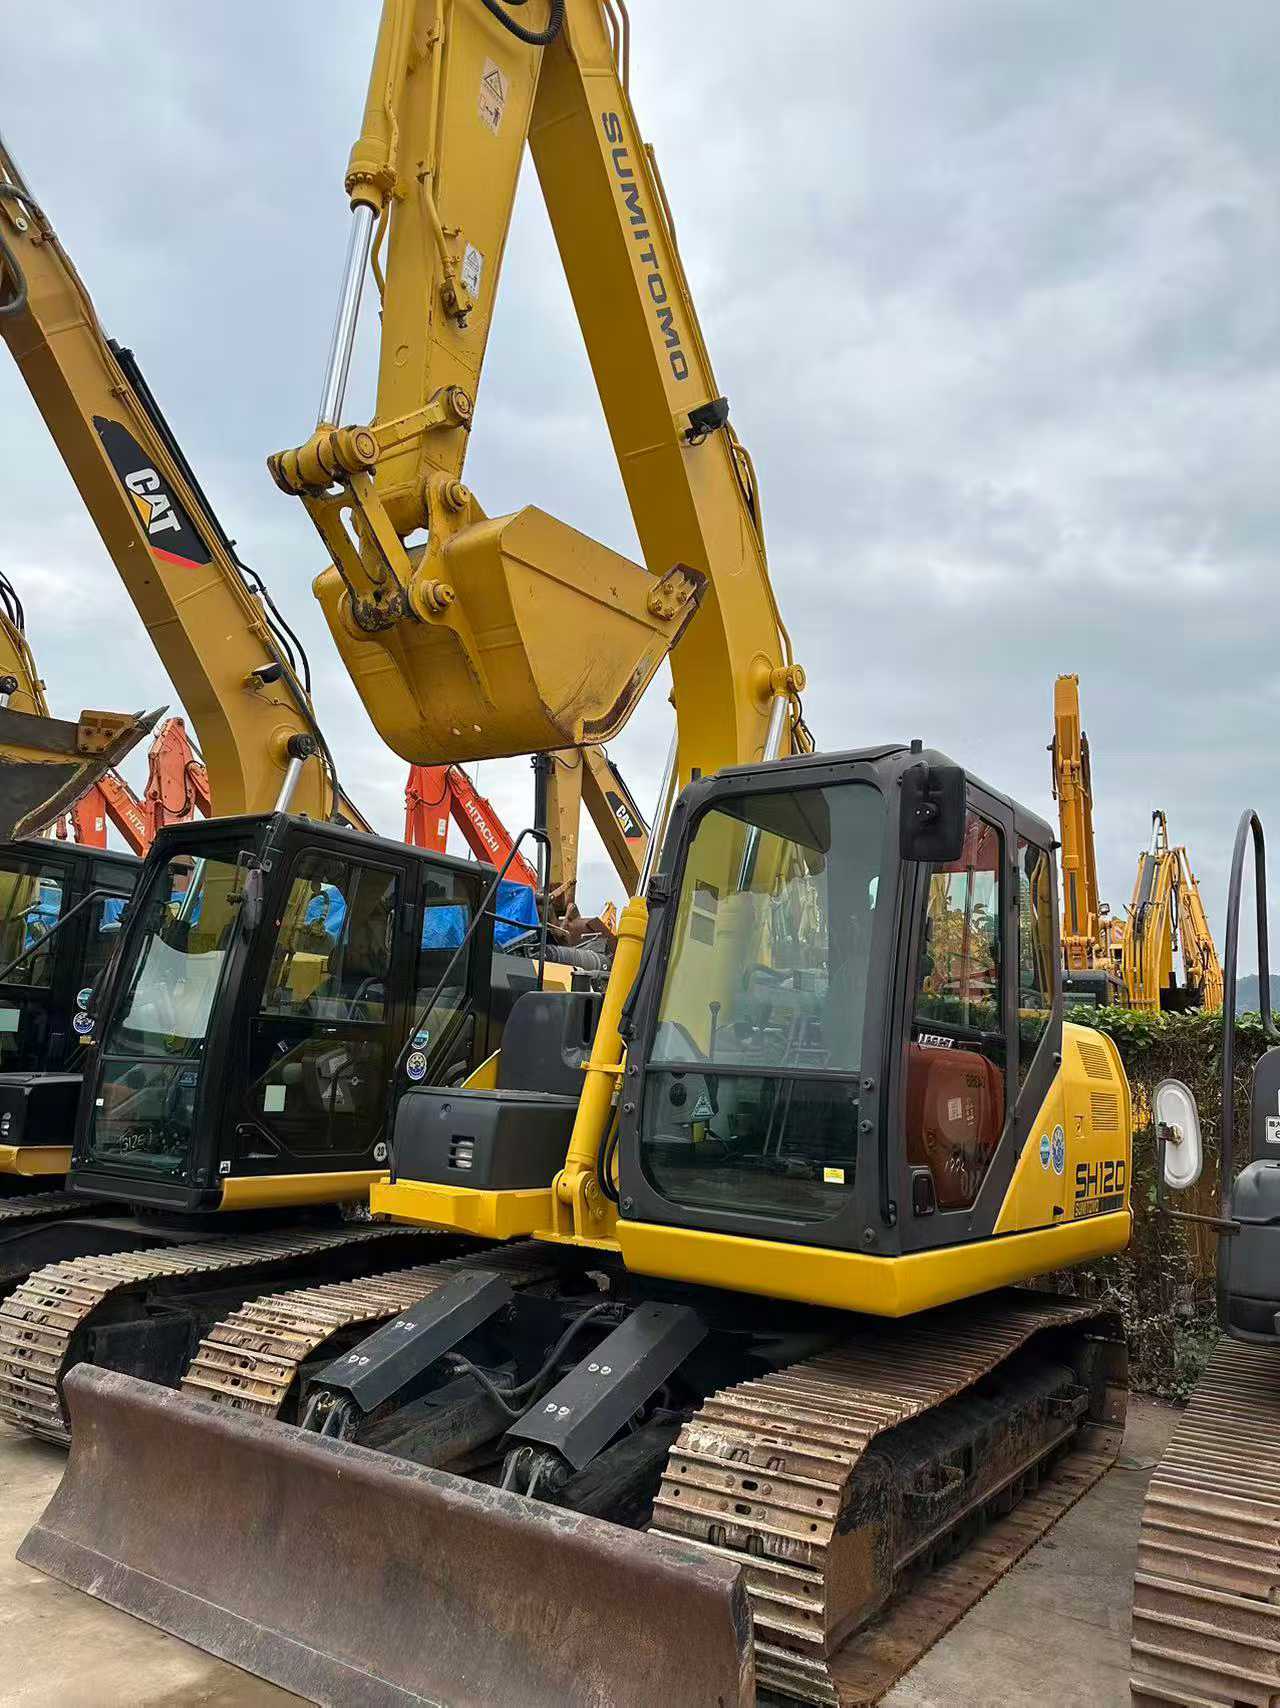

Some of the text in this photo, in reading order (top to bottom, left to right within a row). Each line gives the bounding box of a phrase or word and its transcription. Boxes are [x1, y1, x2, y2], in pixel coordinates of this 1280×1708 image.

[601, 111, 689, 381] SUMITOMO
[125, 467, 182, 535] CAT
[127, 810, 145, 836] HITA
[464, 801, 500, 853] HITACHI
[615, 806, 633, 833] CAT
[1075, 1160, 1125, 1199] SH120
